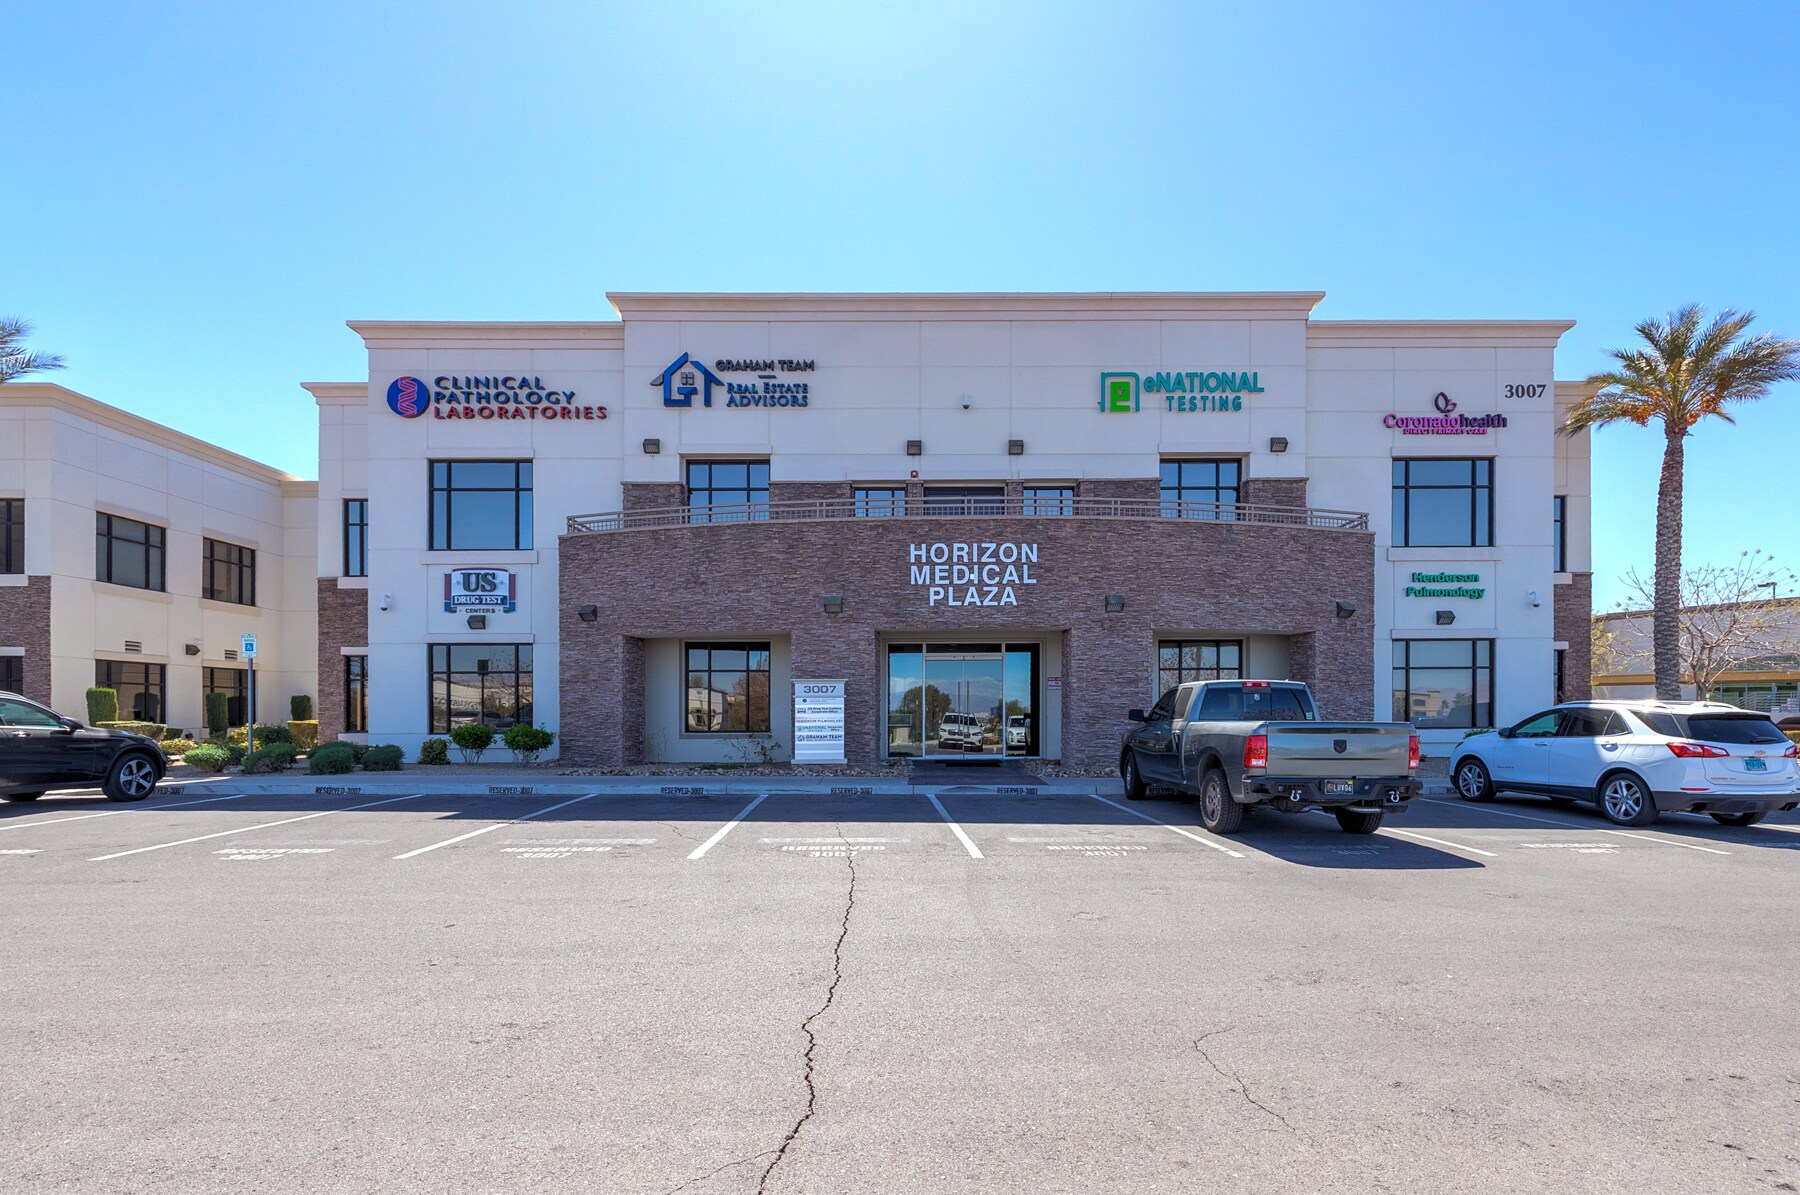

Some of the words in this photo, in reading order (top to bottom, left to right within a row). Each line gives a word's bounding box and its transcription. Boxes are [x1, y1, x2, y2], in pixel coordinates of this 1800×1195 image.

[715, 359, 775, 372] GRAHAM
[778, 359, 815, 372] TEAM
[434, 376, 546, 391] CLINICAL
[1143, 372, 1265, 393] eNATIONAL
[434, 391, 576, 406] PATHOLOGY
[1504, 384, 1547, 399] 3007
[726, 394, 809, 408] ADVISORS
[1166, 395, 1242, 412] TESTING
[434, 406, 608, 420] LABORATORIES
[910, 543, 1038, 563] HORIZON
[461, 572, 497, 592] US
[910, 565, 1037, 585] MEDICAL
[1412, 572, 1480, 582] Henderson
[454, 596, 480, 604] DRUG
[481, 596, 503, 604] TEST
[929, 586, 1018, 606] PLAZA
[1405, 586, 1485, 599] Pulmonology
[803, 685, 837, 694] 3007
